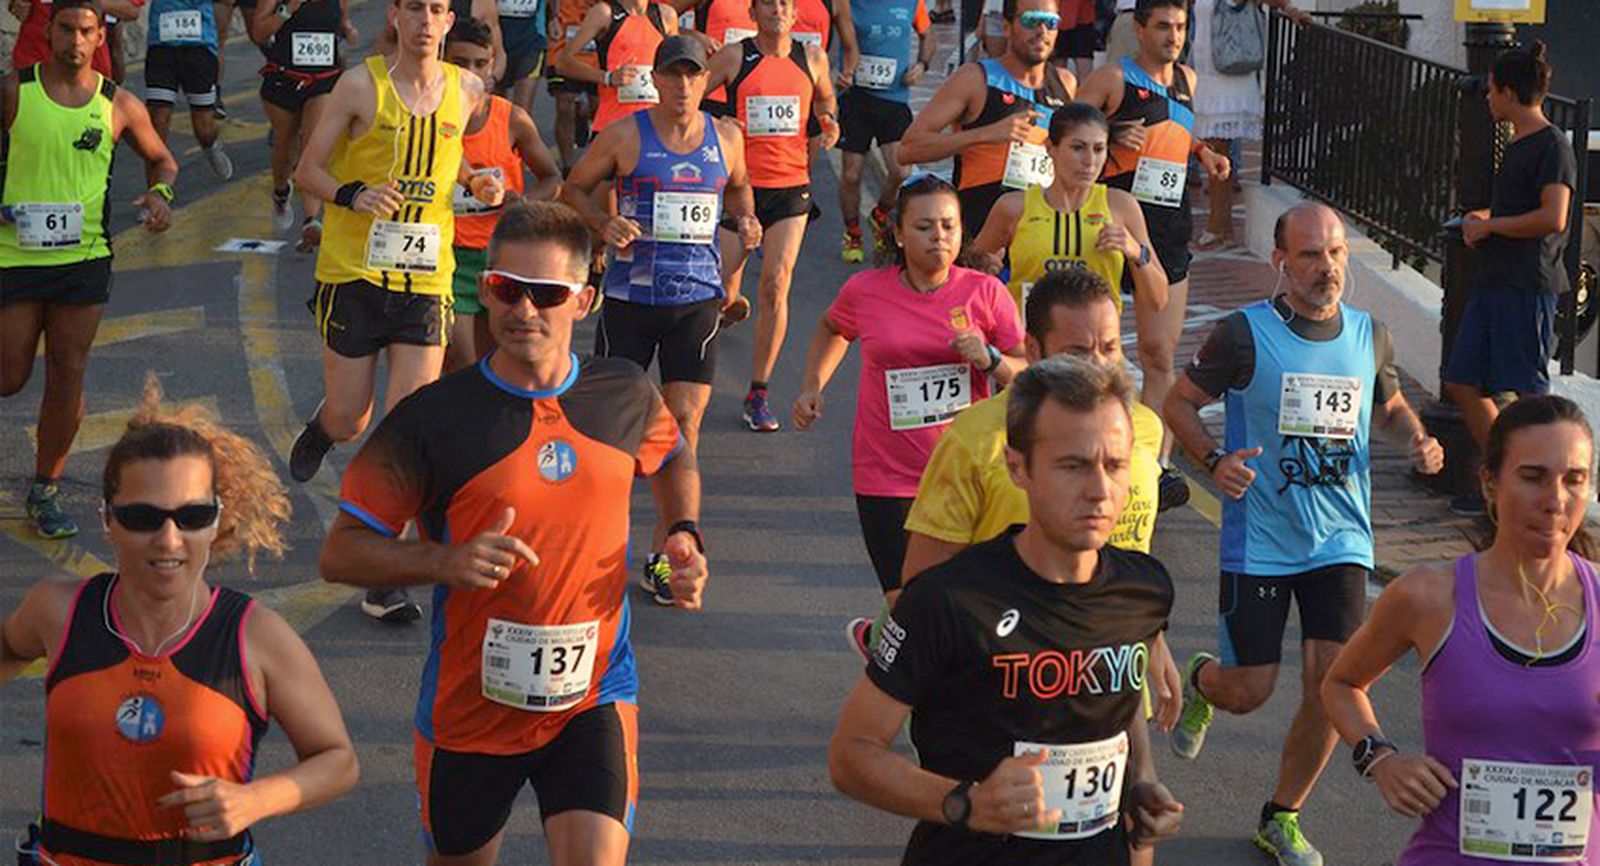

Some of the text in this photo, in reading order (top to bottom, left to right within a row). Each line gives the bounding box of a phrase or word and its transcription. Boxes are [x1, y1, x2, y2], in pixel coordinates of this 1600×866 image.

[175, 17, 196, 28] 184
[297, 43, 331, 56] 2690
[870, 64, 892, 78] 195
[767, 105, 794, 119] 106
[1160, 171, 1178, 188] 89
[46, 213, 67, 231] 61
[680, 205, 712, 223] 169
[402, 235, 426, 253] 74
[919, 377, 960, 402] 175
[1313, 390, 1352, 413] 143
[530, 643, 586, 676] 137
[992, 641, 1148, 699] TOKYO
[1484, 764, 1514, 775] XXXIV
[1064, 760, 1117, 800] 130
[1484, 774, 1519, 785] CIUDAD
[1521, 777, 1533, 786] DE
[1512, 786, 1579, 822] 122
